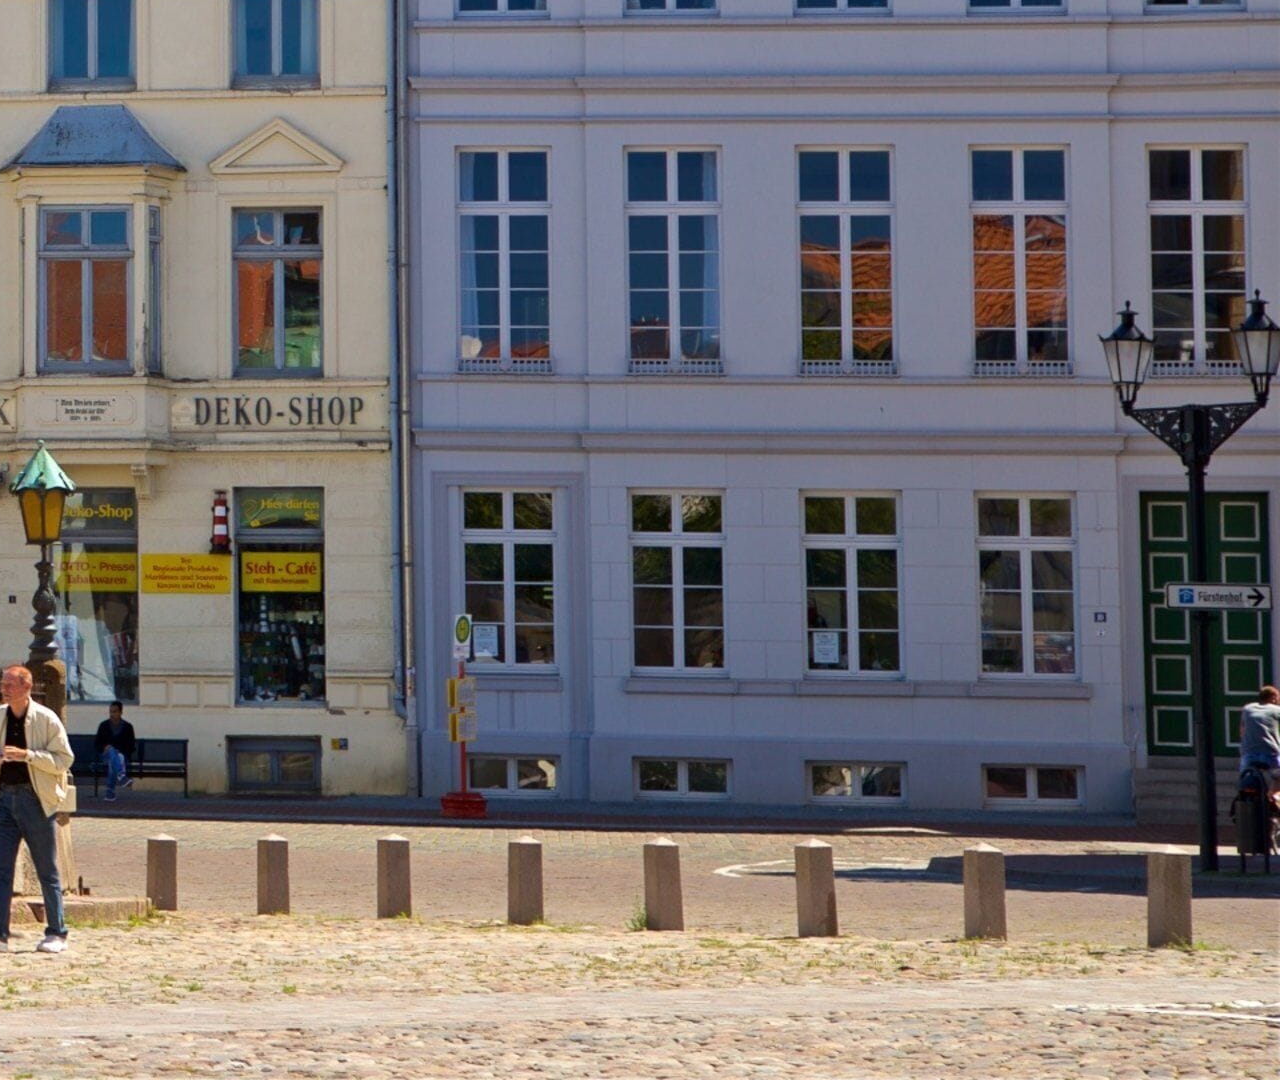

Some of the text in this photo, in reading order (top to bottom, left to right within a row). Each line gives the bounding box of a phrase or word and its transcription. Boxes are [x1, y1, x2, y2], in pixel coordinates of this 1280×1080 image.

[194, 396, 364, 426] DEKO-SHOP
[100, 562, 136, 572] Presse
[245, 561, 275, 575] Steh
[285, 561, 317, 575] Café
